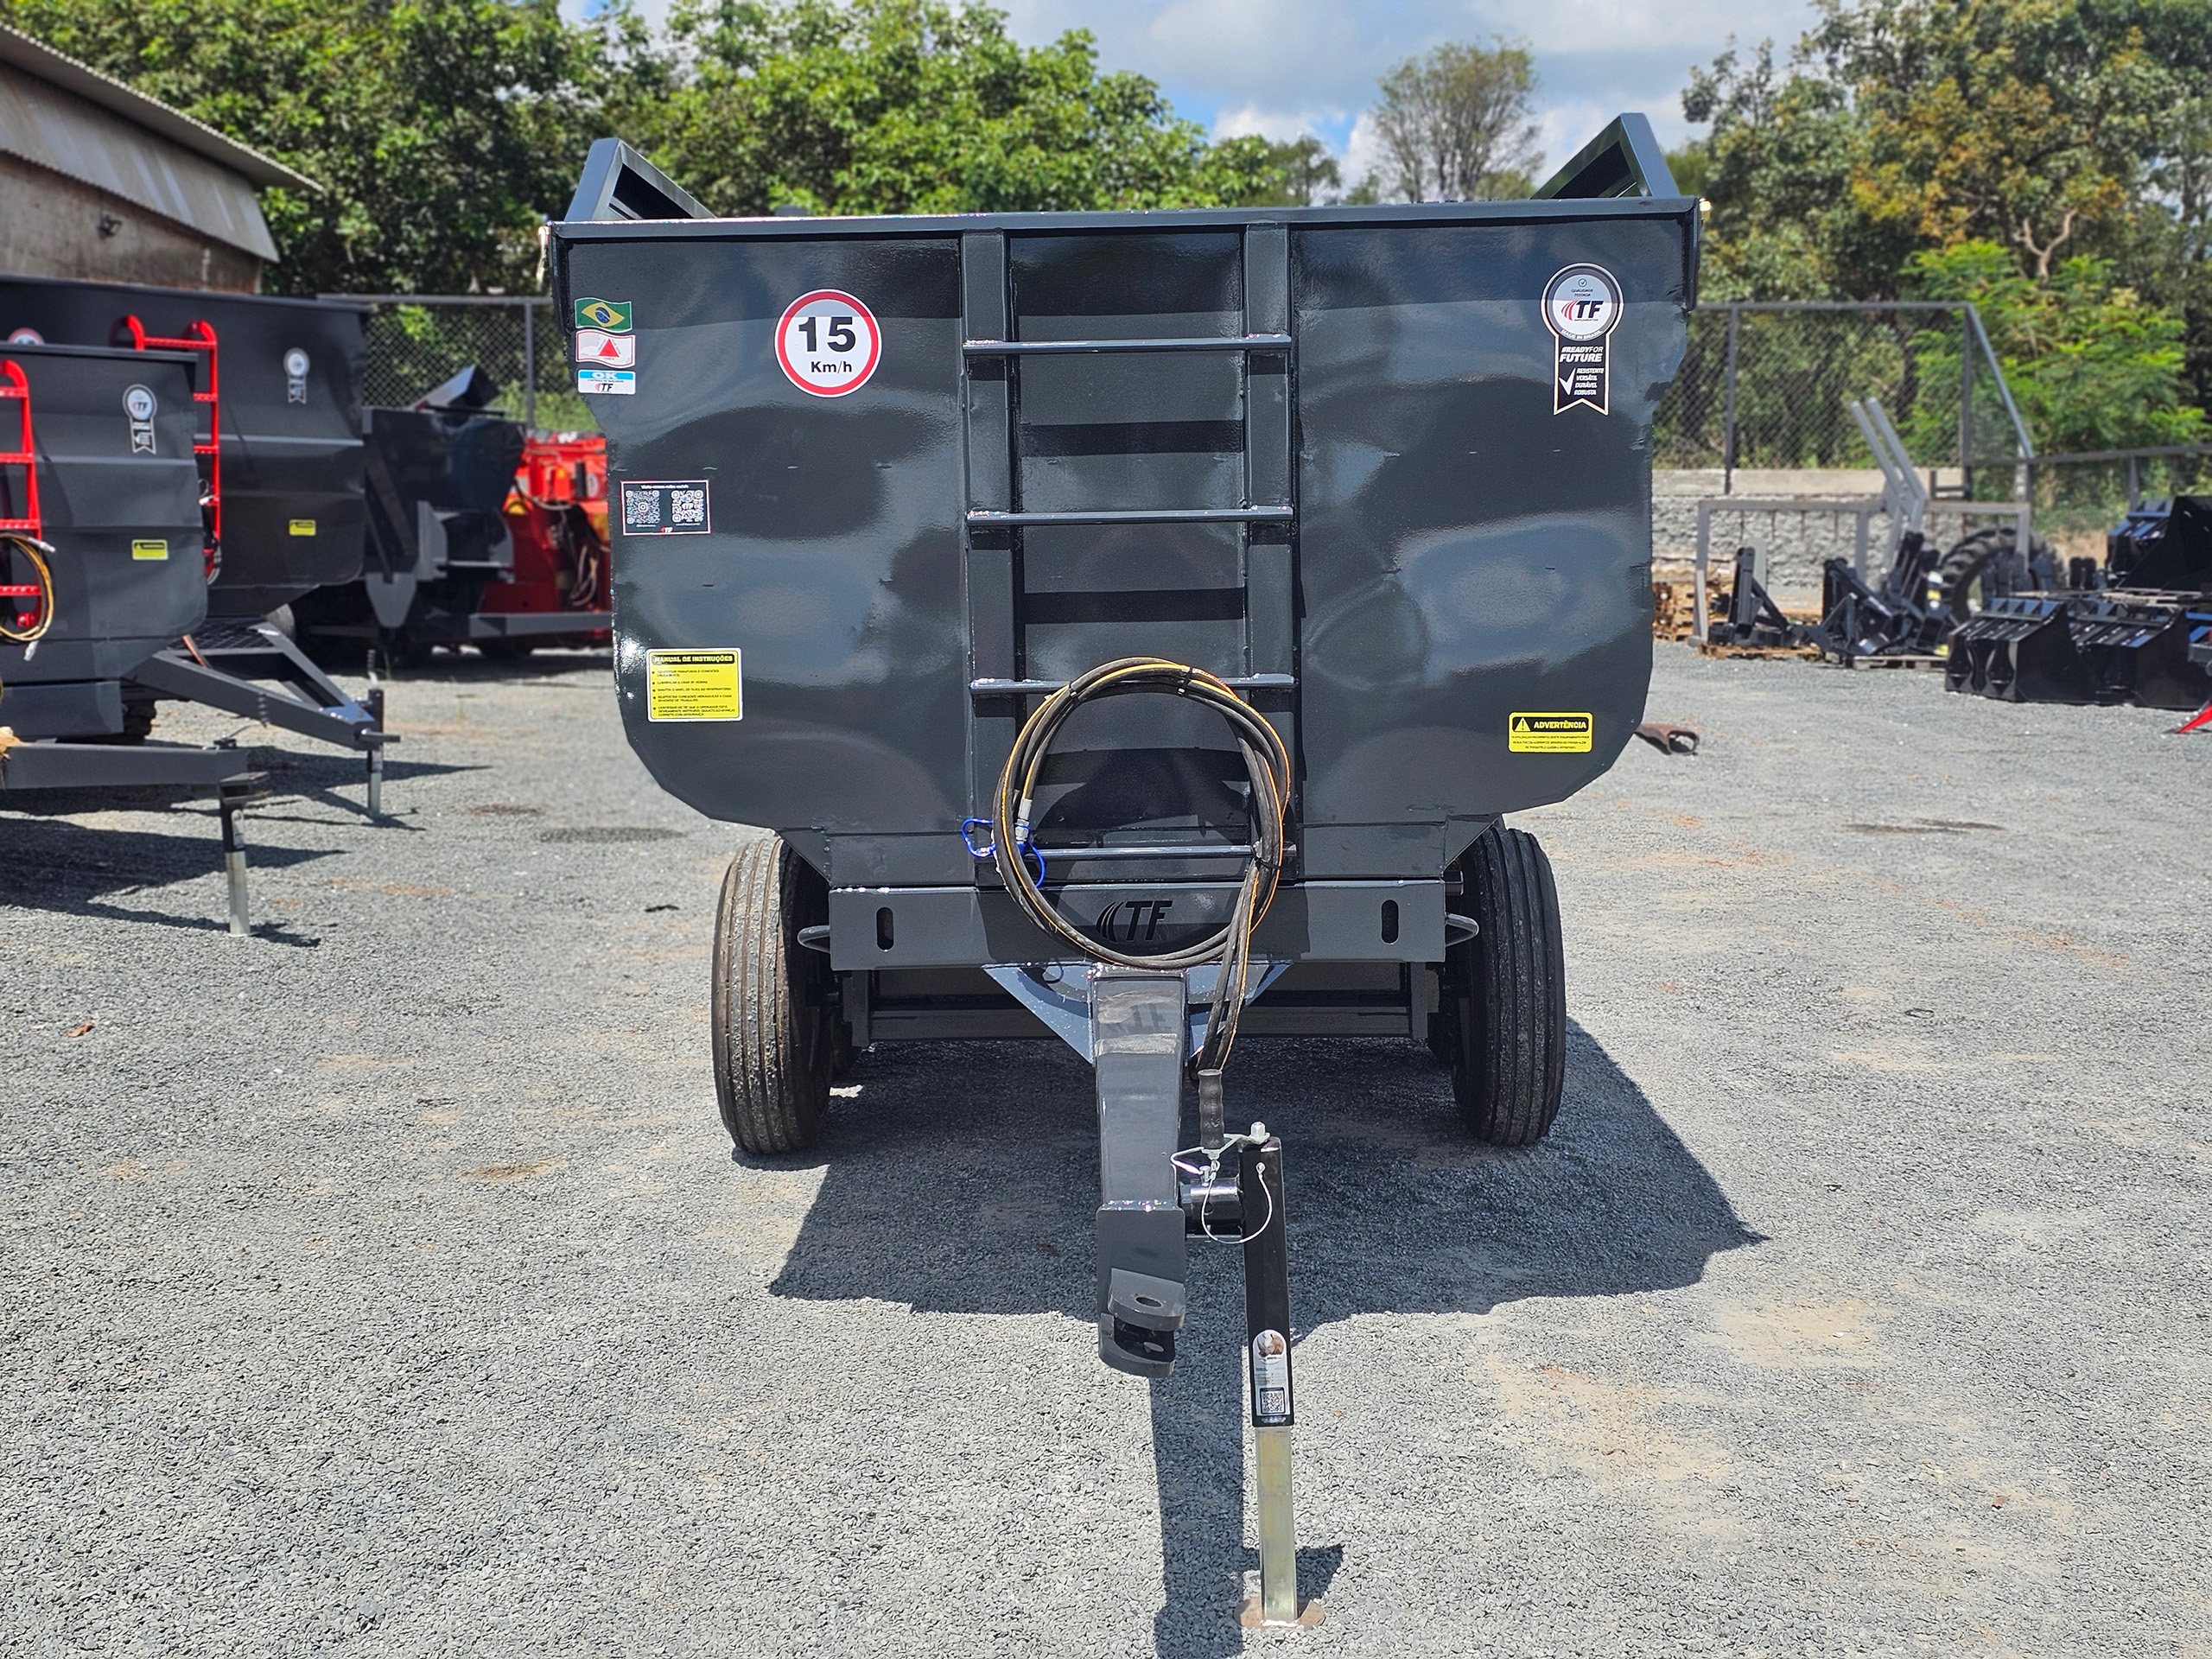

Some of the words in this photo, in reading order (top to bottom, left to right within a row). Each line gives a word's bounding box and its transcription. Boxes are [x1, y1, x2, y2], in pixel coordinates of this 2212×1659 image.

[1576, 300, 1604, 318] TF
[798, 316, 856, 353] 15
[1559, 353, 1604, 363] FUTURE
[810, 360, 853, 374] Km/h
[592, 372, 618, 380] OK
[692, 655, 733, 664] INSTRUÇÕES
[1533, 720, 1586, 729] ADVERTÊNCIA
[1125, 900, 1173, 941] TF
